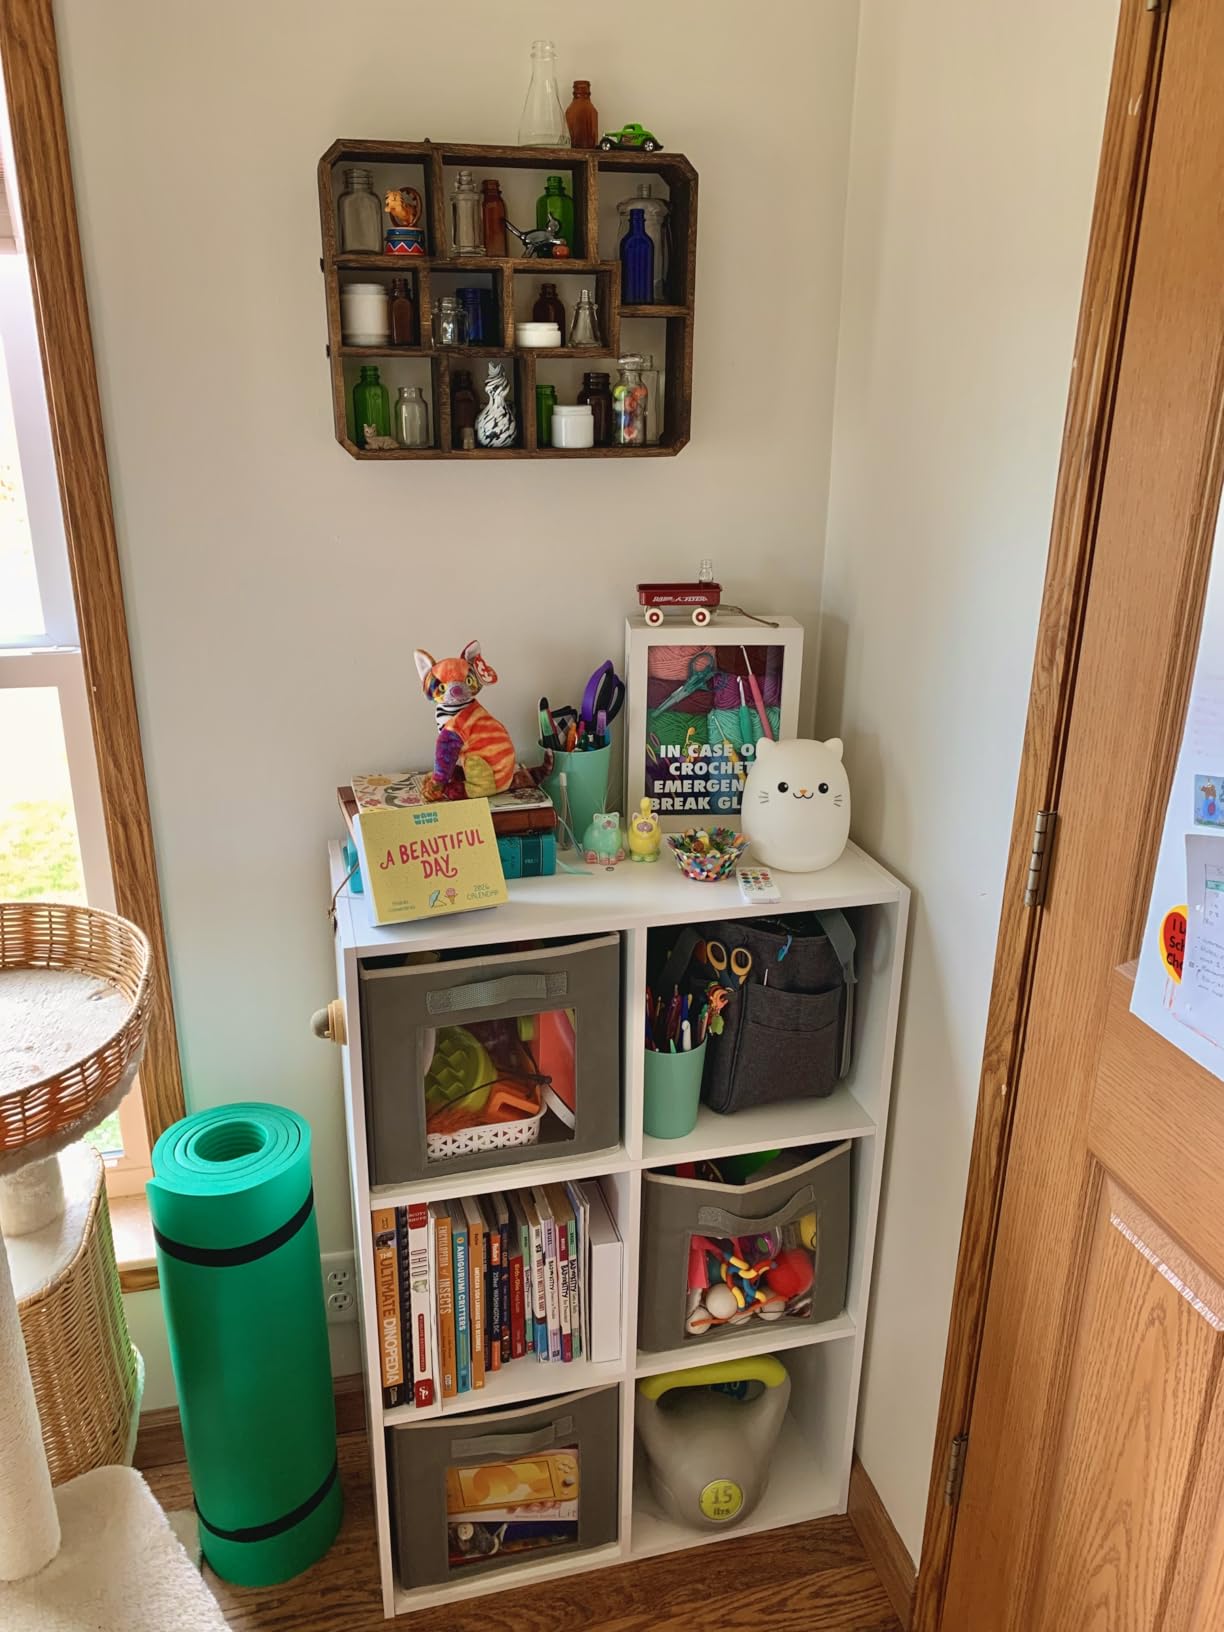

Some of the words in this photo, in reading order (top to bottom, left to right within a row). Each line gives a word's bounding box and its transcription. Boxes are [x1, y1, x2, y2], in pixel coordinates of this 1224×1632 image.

[660, 745, 680, 757] IN
[687, 744, 733, 757] CASE
[741, 744, 754, 756] O
[669, 762, 752, 775] CROCHET
[654, 779, 743, 793] EMERGEN
[650, 797, 711, 810] BREAK
[380, 850, 395, 870] A
[399, 829, 484, 864] BEAUTIFUL
[421, 854, 458, 879] DAY
[1179, 920, 1186, 934] L
[1169, 936, 1185, 952] Sch
[410, 1248, 427, 1278] OHIO
[457, 1246, 466, 1293] AMIGURUMI
[380, 1256, 396, 1317] ULTIMATE
[439, 1278, 452, 1314] INSECTS
[458, 1294, 467, 1331] CRITTERS
[383, 1317, 400, 1385] DINOPEDIA
[711, 1486, 732, 1504] 15
